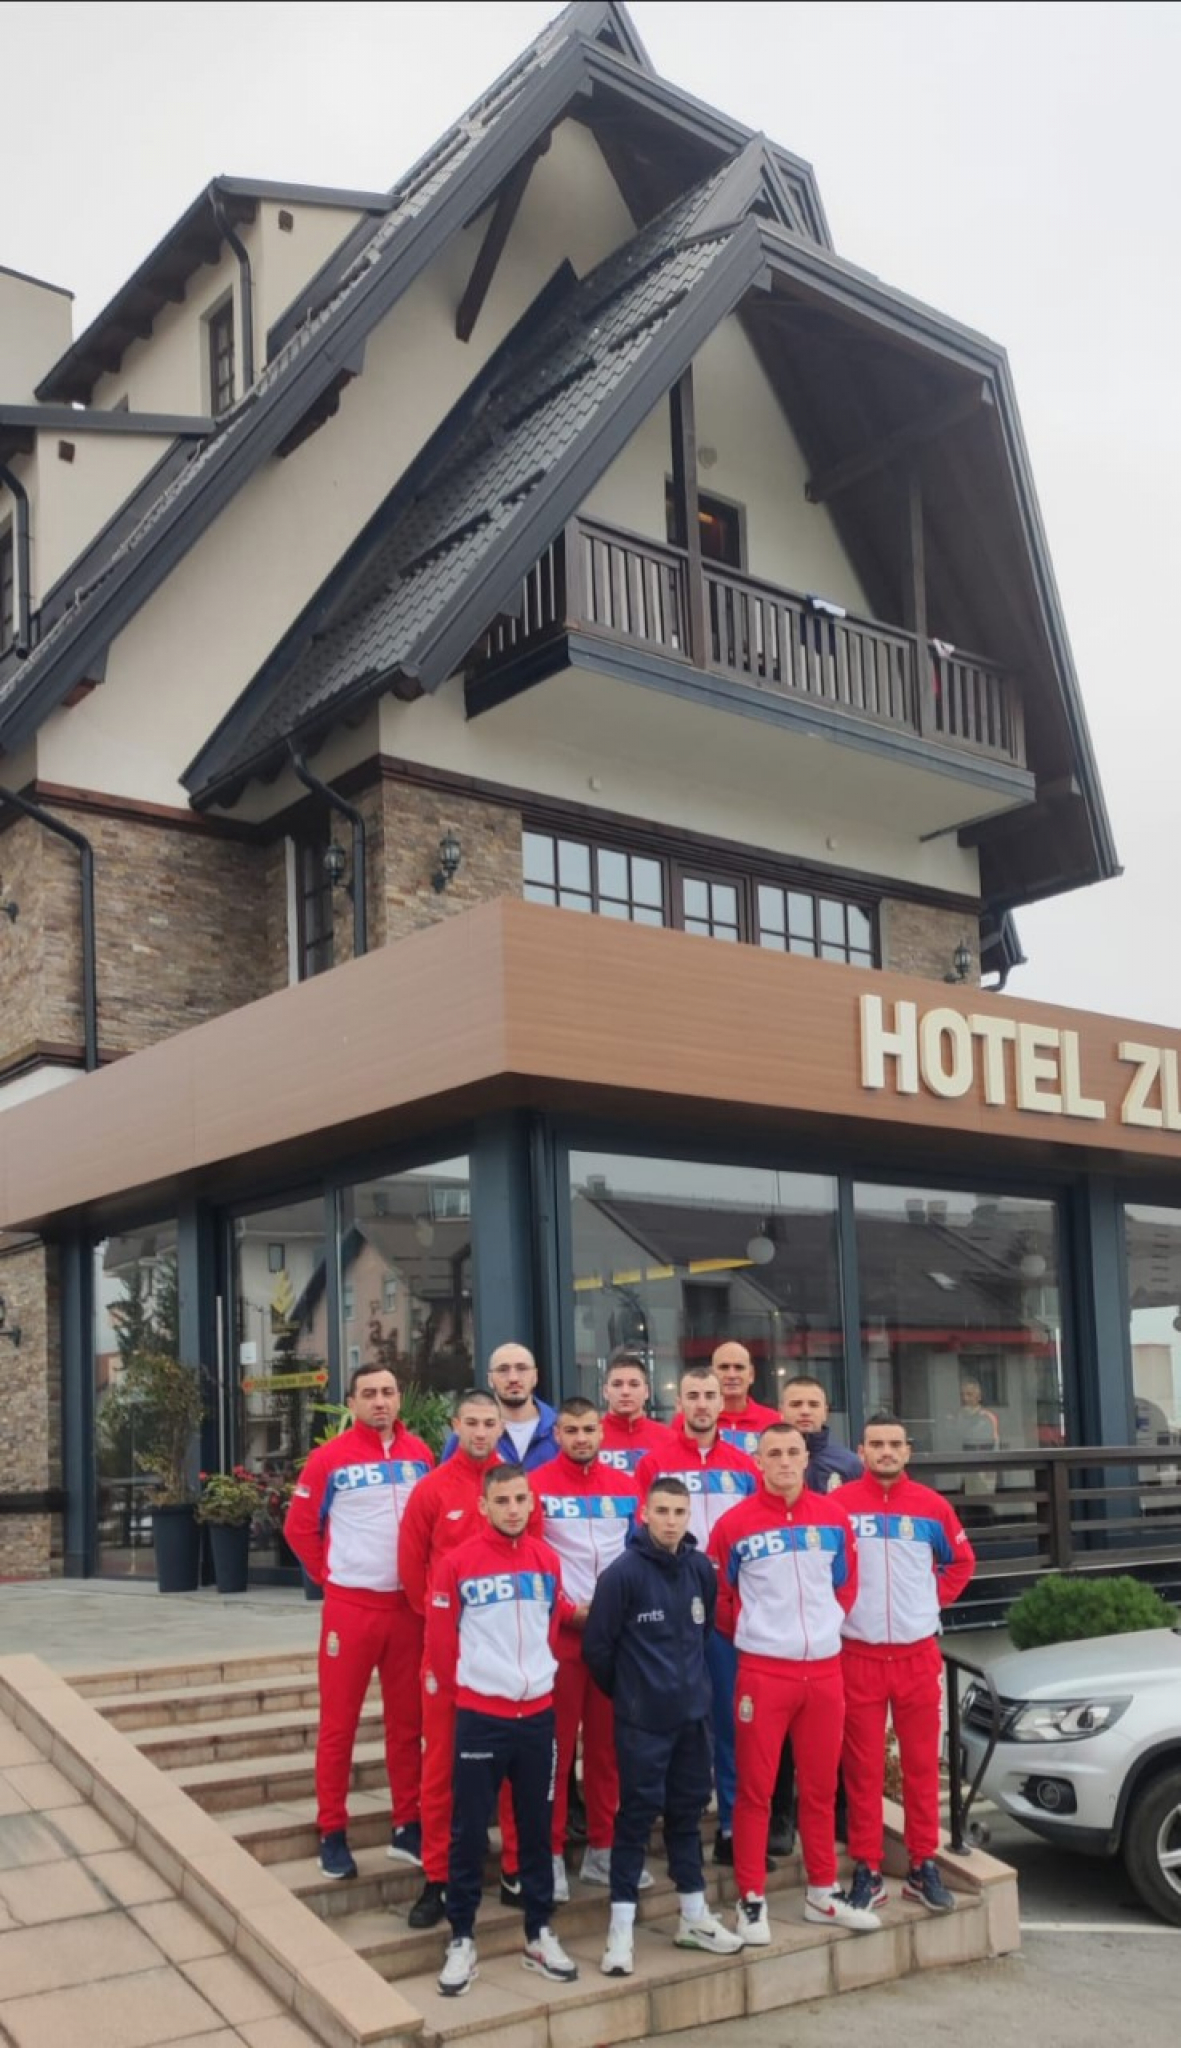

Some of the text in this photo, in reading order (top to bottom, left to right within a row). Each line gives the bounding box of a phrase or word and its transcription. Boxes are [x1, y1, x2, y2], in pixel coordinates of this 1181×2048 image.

[860, 994, 1106, 1119] HOTEL
[598, 1450, 628, 1469] РБ
[334, 1463, 384, 1490] СРБ
[540, 1495, 580, 1518] РБ
[736, 1530, 785, 1561] СРБ
[461, 1575, 514, 1605] СРБ
[637, 1610, 665, 1623] mts
